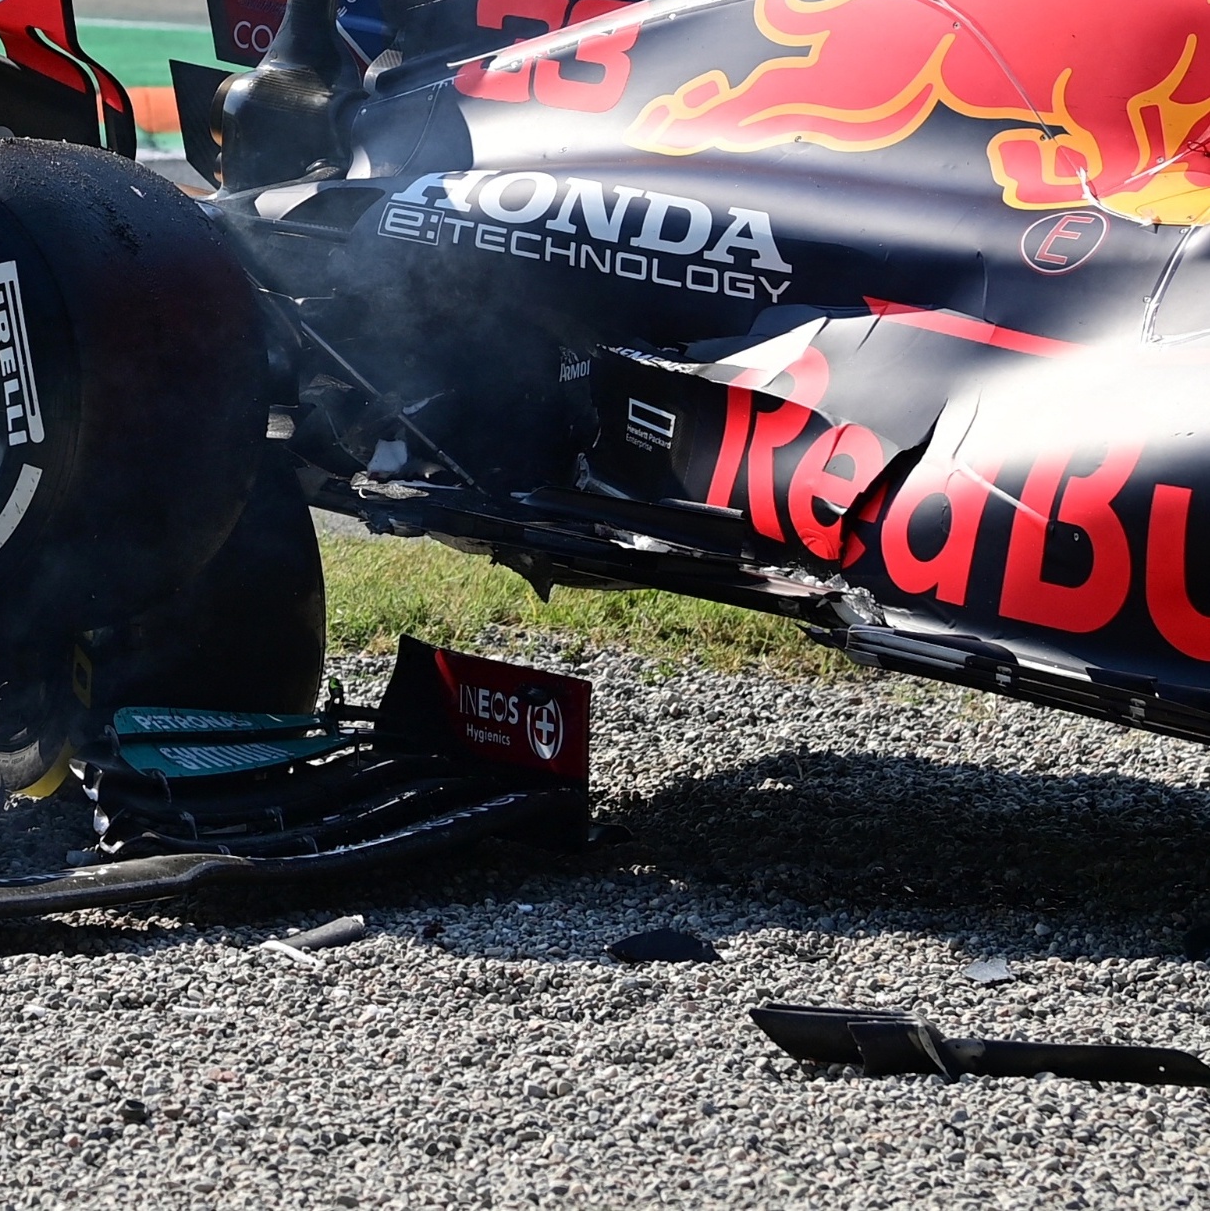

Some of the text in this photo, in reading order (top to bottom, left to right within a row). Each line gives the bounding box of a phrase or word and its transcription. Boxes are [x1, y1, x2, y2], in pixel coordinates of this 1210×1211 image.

[391, 170, 793, 274] HONDA
[1034, 215, 1095, 265] E
[626, 423, 672, 450] Hewlett Packard
[459, 683, 519, 725] INEOS
[466, 722, 511, 746] Hygienics
